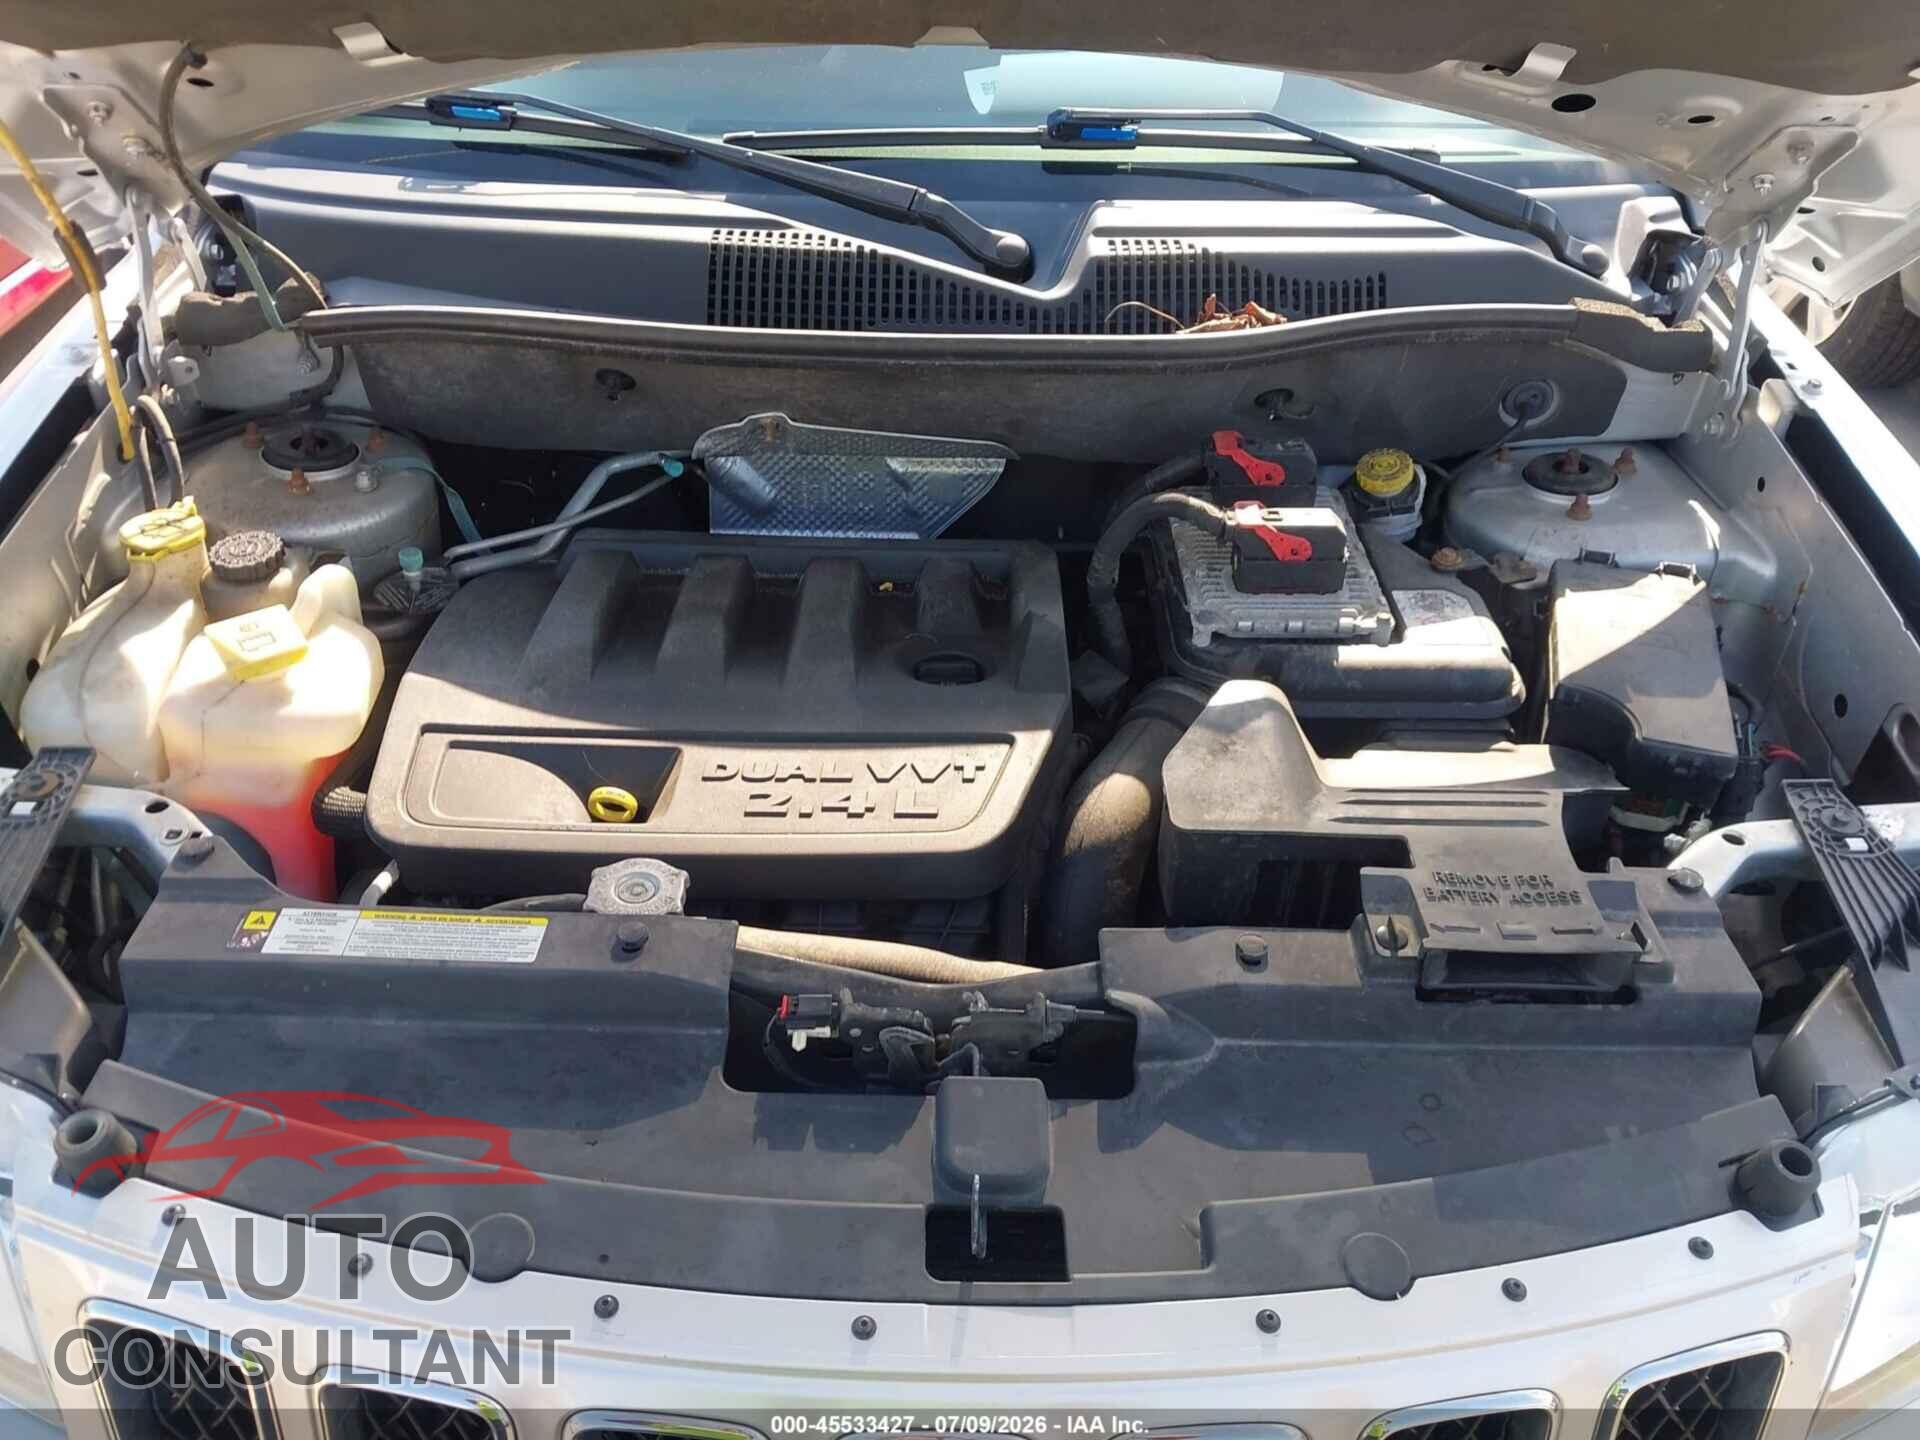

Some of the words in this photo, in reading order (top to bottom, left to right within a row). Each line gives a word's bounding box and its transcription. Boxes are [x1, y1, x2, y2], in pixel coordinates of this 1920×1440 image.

[702, 761, 853, 783] DUAL
[866, 761, 986, 783] VVT
[743, 790, 939, 819] 2.4L
[1432, 871, 1511, 889] REMOVE
[1515, 873, 1554, 889] FOR
[1423, 886, 1500, 904] BATTERY
[1510, 889, 1583, 907] ACCESS
